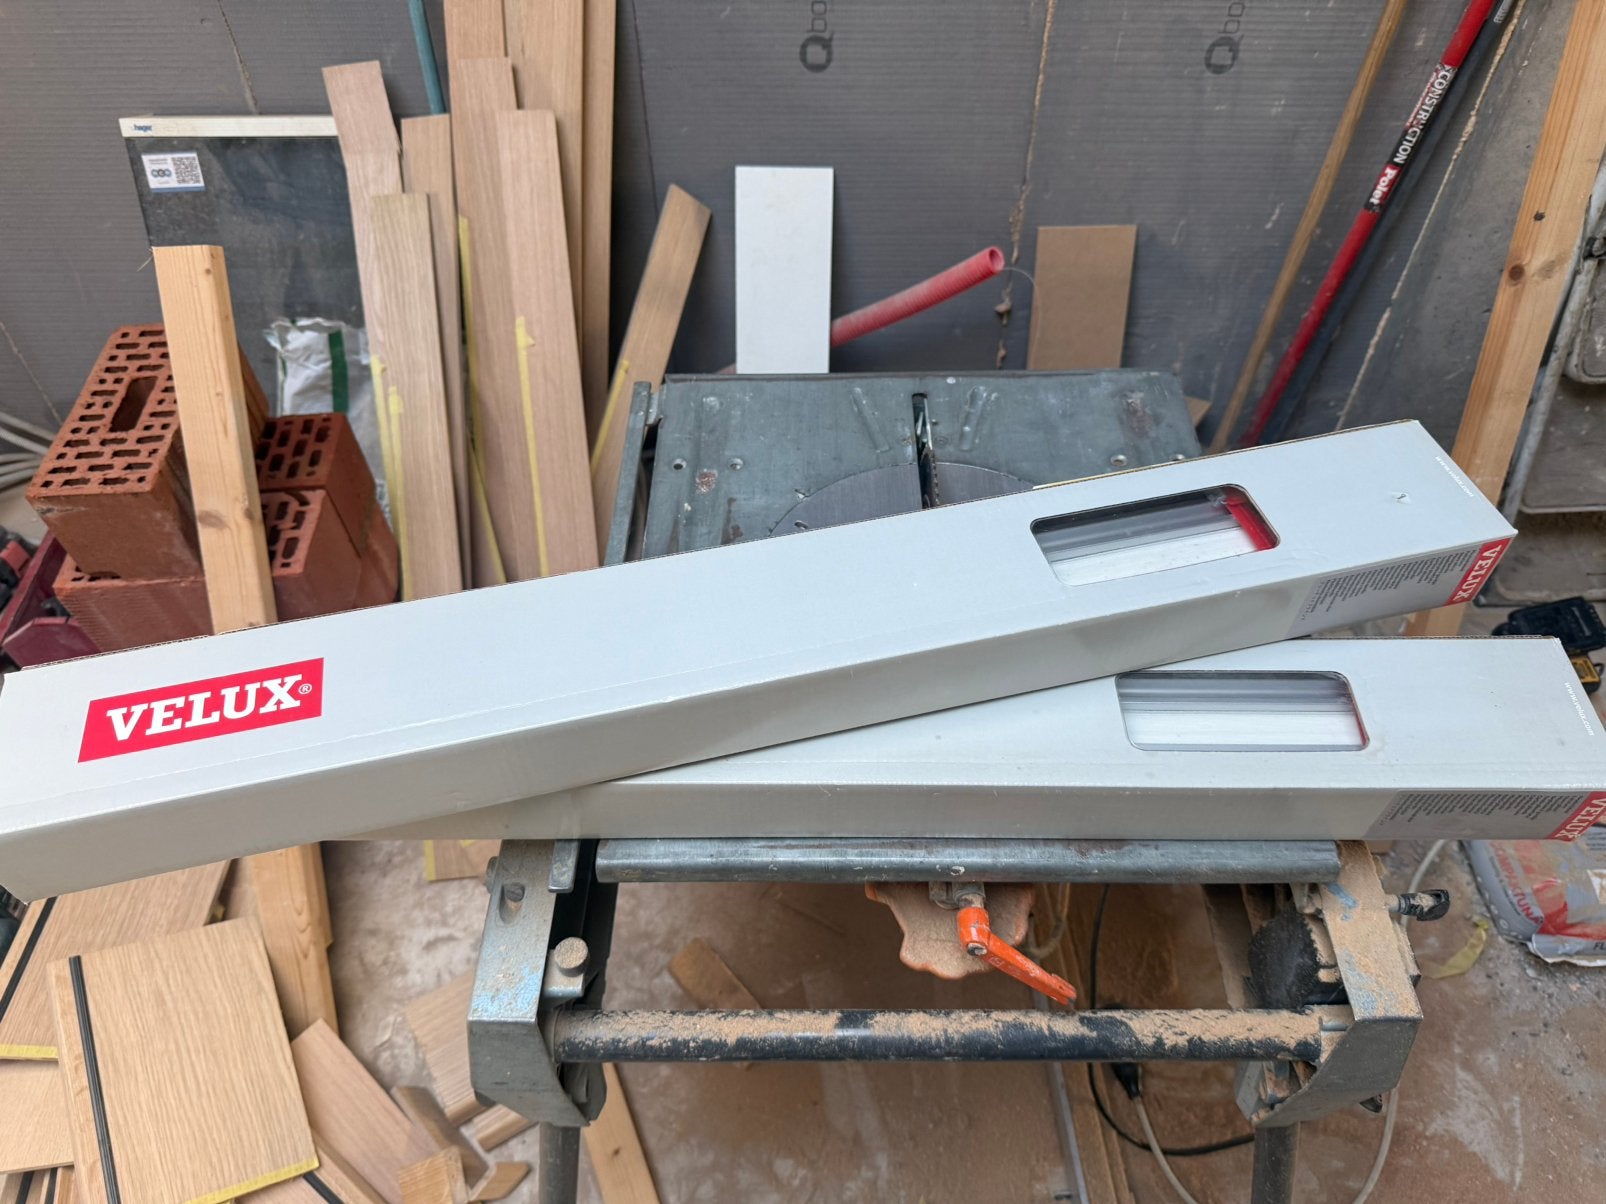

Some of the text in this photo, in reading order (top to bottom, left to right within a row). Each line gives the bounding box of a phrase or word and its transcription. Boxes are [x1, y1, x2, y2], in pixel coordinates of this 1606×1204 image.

[1452, 544, 1502, 601] VELUX
[1564, 682, 1595, 736] www.velux.com
[1554, 798, 1606, 839] VELUX
